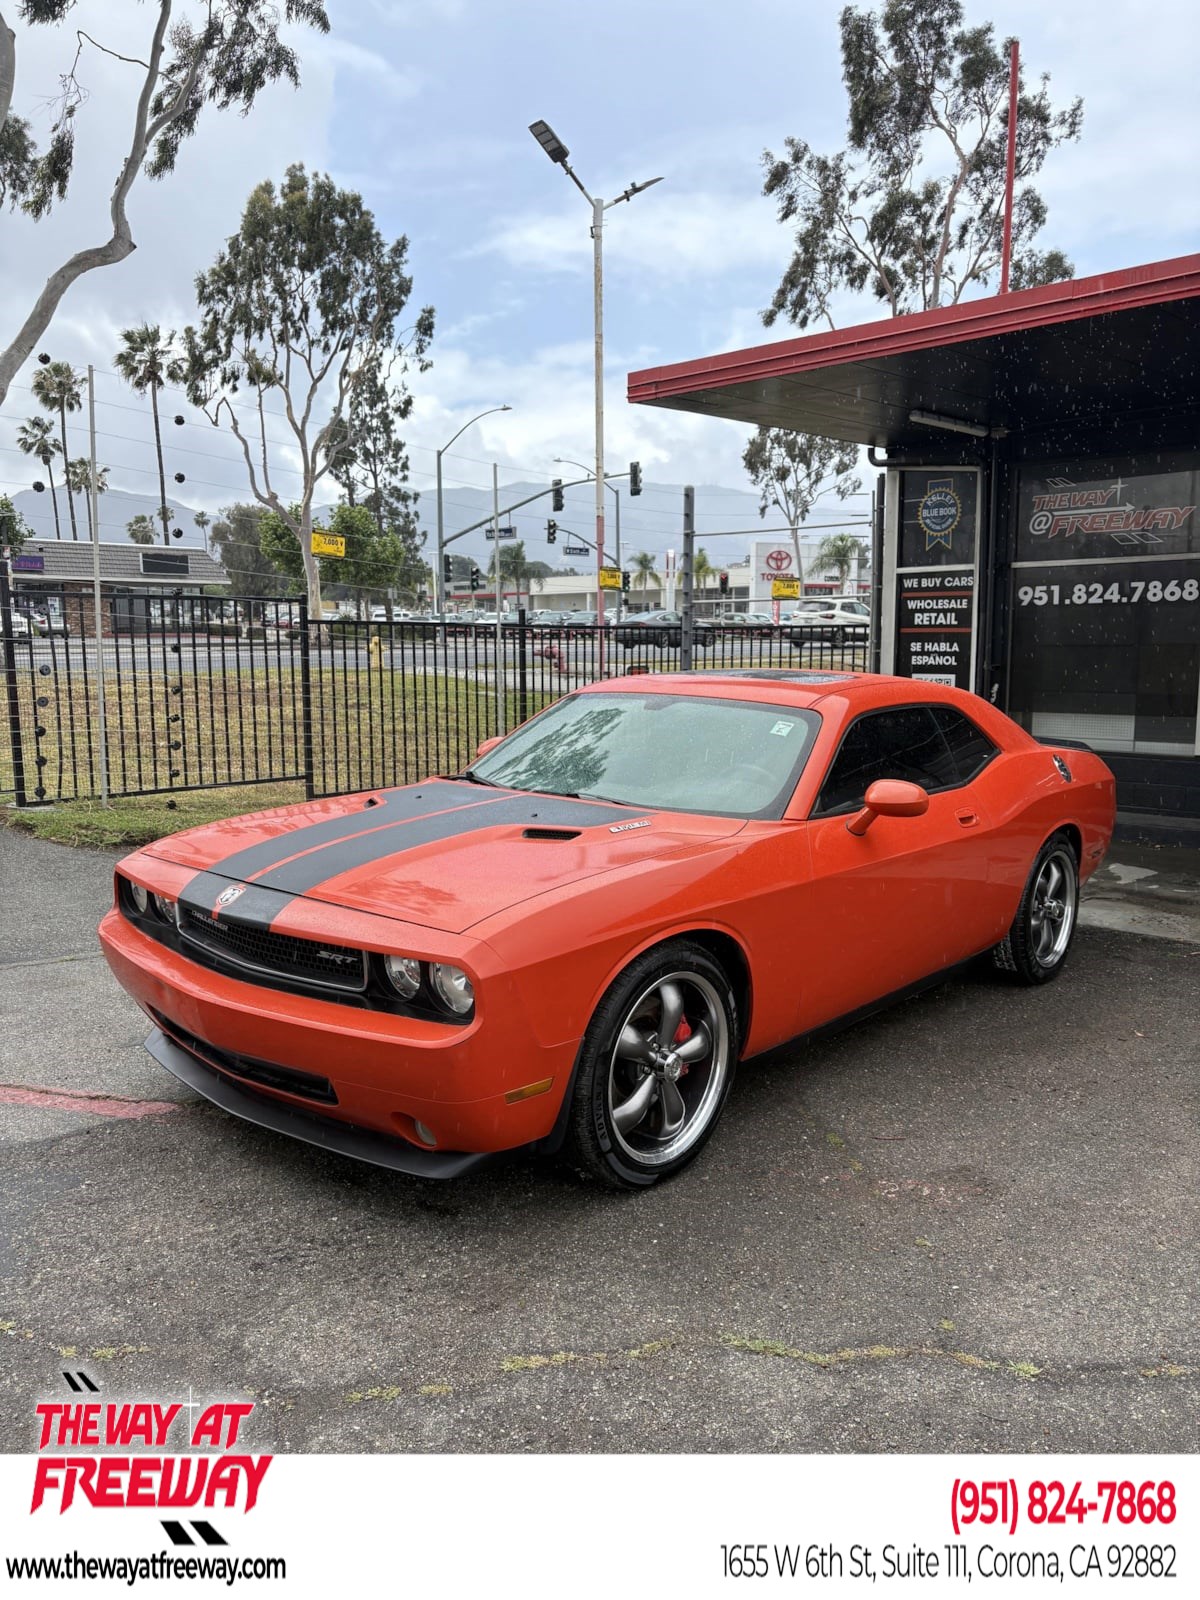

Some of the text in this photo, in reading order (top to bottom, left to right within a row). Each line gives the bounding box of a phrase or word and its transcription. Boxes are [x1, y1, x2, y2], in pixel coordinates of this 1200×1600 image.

[926, 492, 955, 506] KELLEY
[1032, 488, 1117, 512] THE WAY
[922, 506, 957, 517] BLUE BOOK
[903, 576, 974, 588] WE BUY CARS
[1017, 578, 1200, 606] 951.824.7868
[907, 599, 969, 610] WHOLESALE
[914, 612, 958, 625] RETAIL
[910, 642, 960, 652] SE HABLA
[316, 950, 358, 965] SRT
